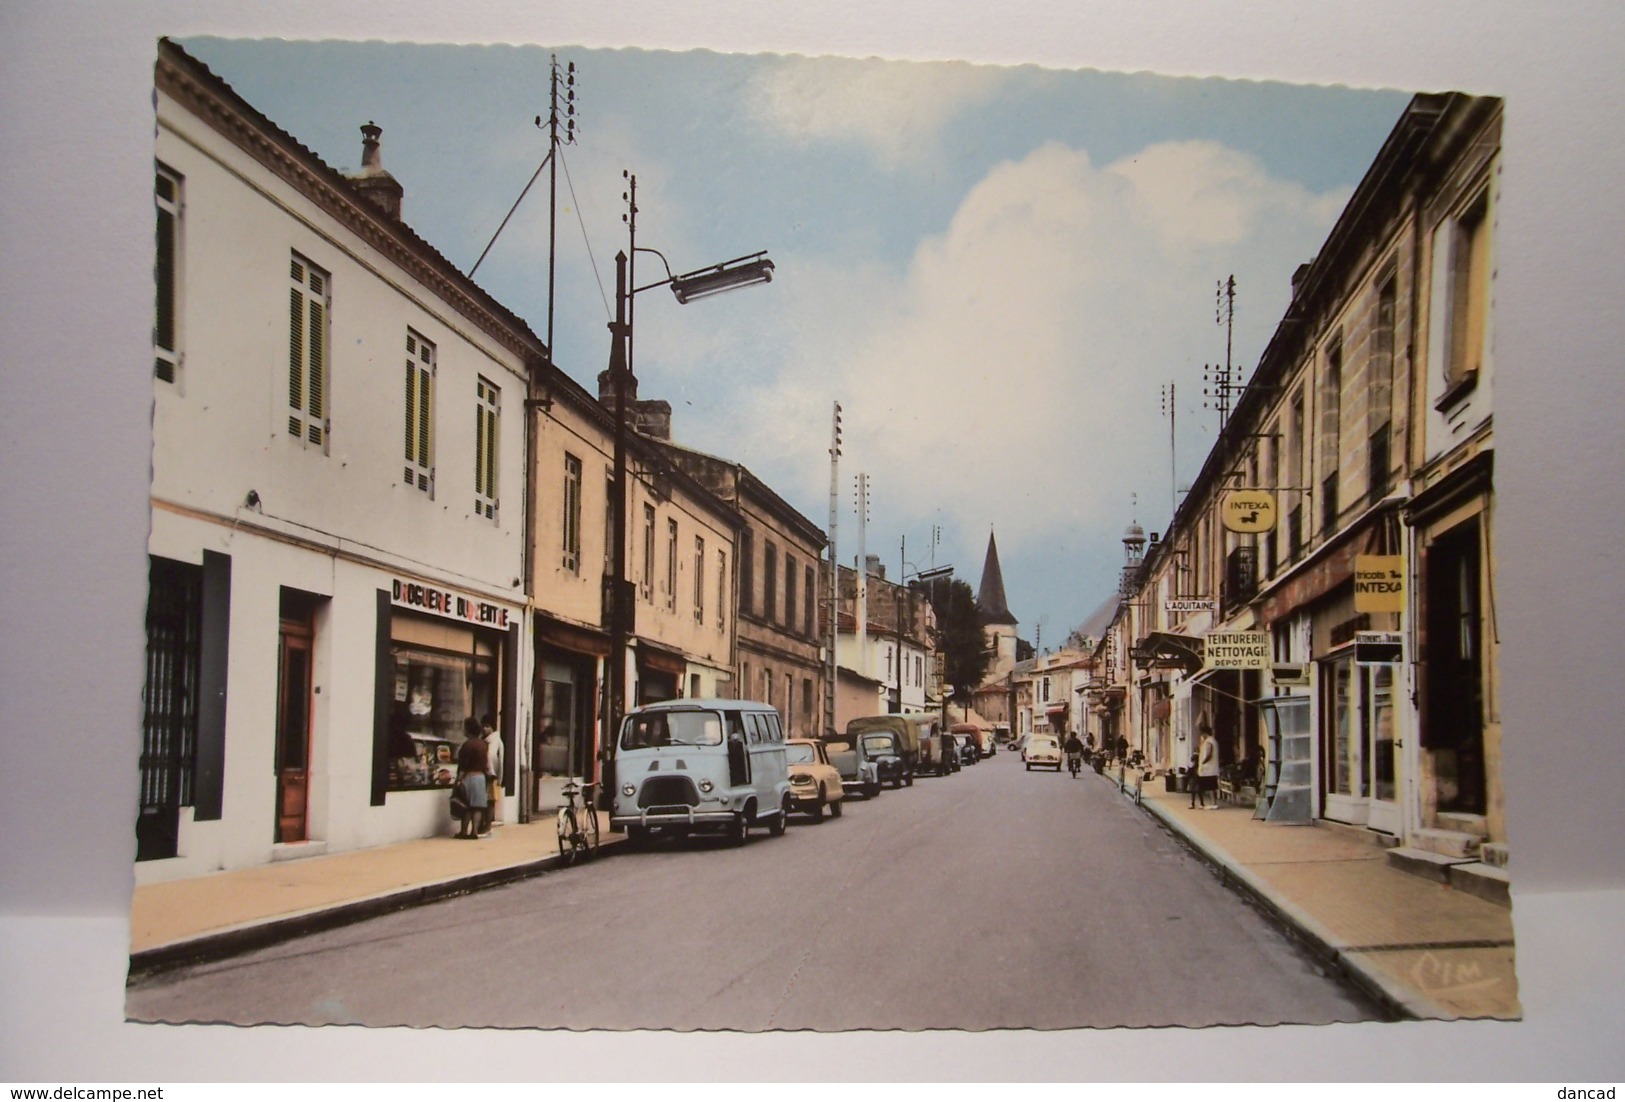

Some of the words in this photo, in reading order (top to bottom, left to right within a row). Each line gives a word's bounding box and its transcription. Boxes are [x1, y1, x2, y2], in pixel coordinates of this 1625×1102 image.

[1230, 501, 1270, 510] INTEXA
[1356, 570, 1386, 580] tricots
[1356, 582, 1402, 593] INTEXA
[1165, 601, 1215, 610] L'AQUITAINE
